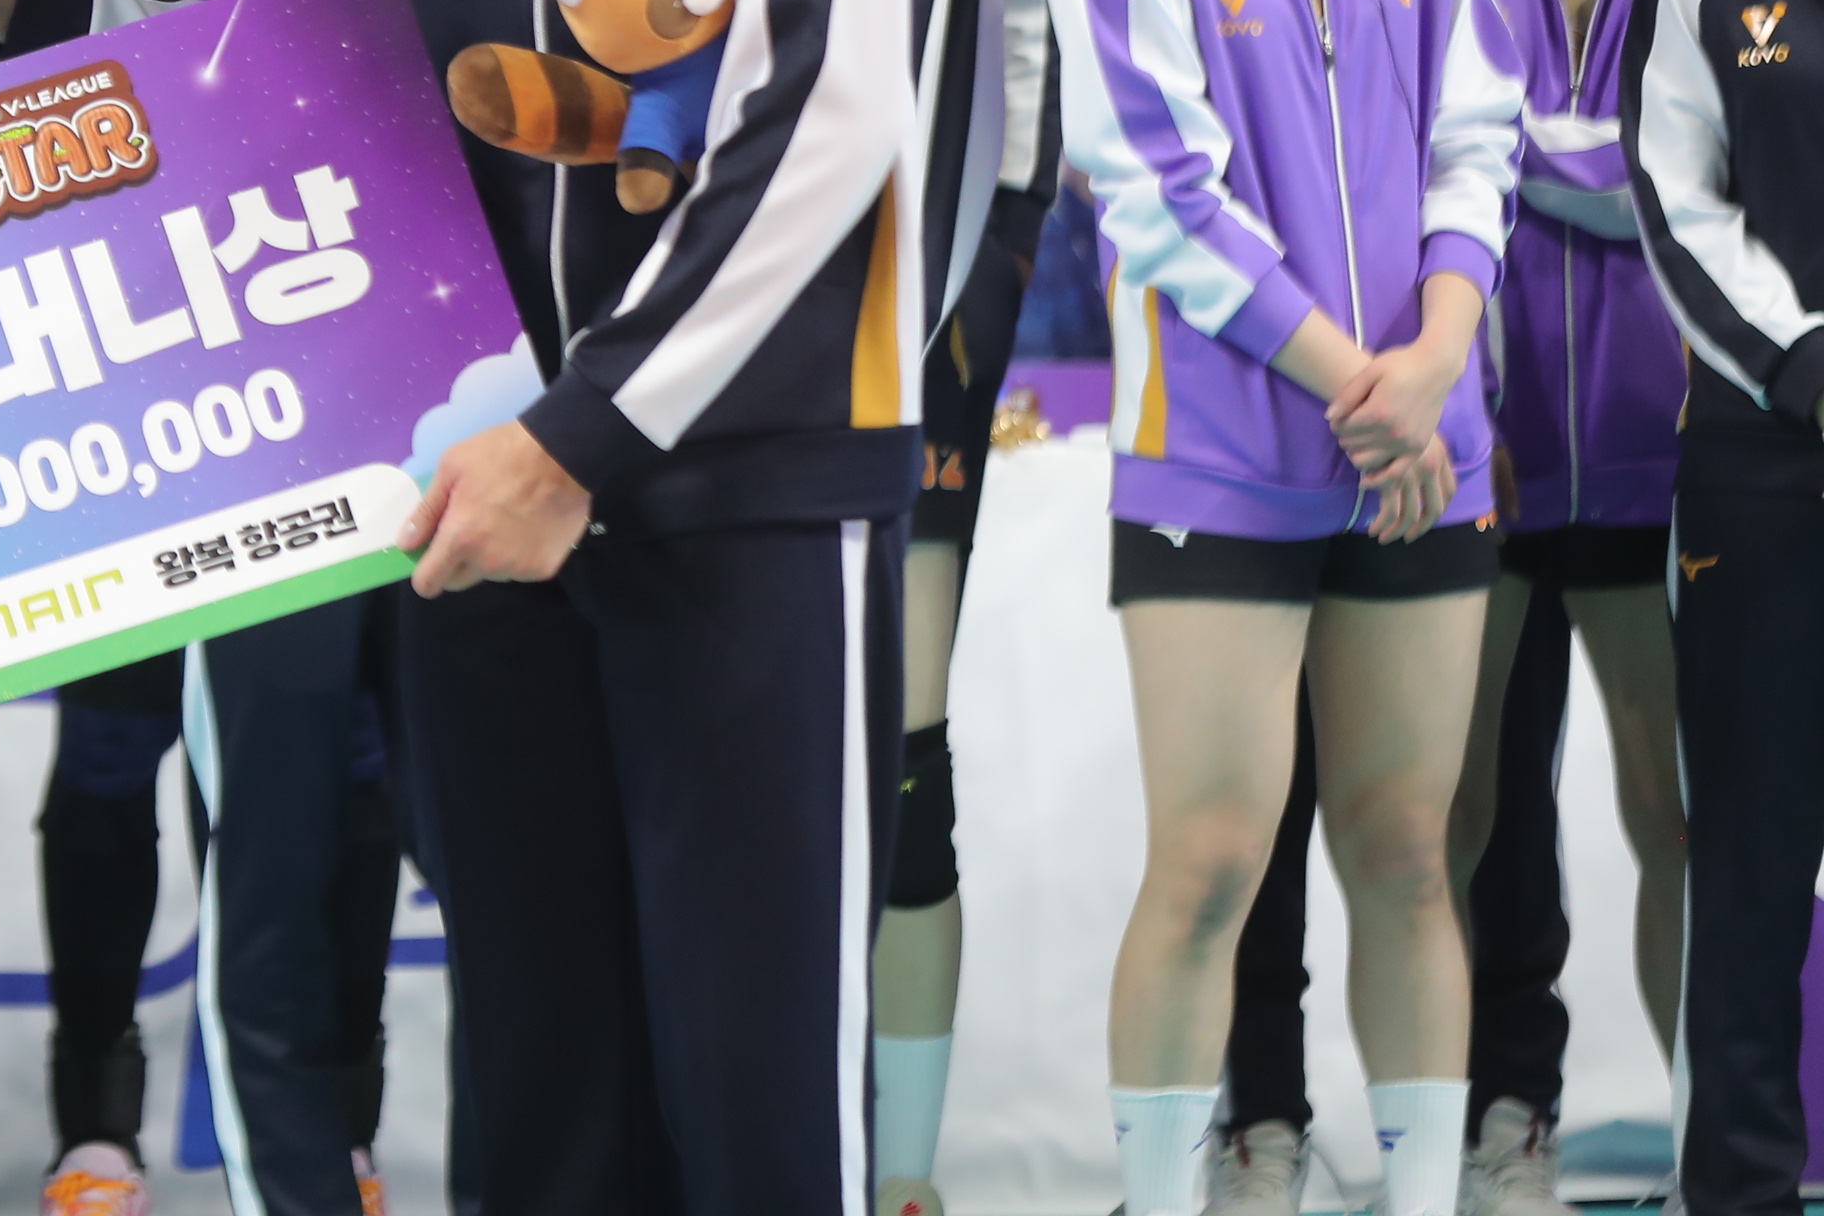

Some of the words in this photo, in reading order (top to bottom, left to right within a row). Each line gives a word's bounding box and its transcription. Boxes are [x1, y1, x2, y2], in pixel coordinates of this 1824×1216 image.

[1737, 43, 1791, 68] KOVO
[0, 70, 114, 118] V-LEAGUE
[151, 534, 238, 590] 왕복
[234, 495, 359, 564] 항공권
